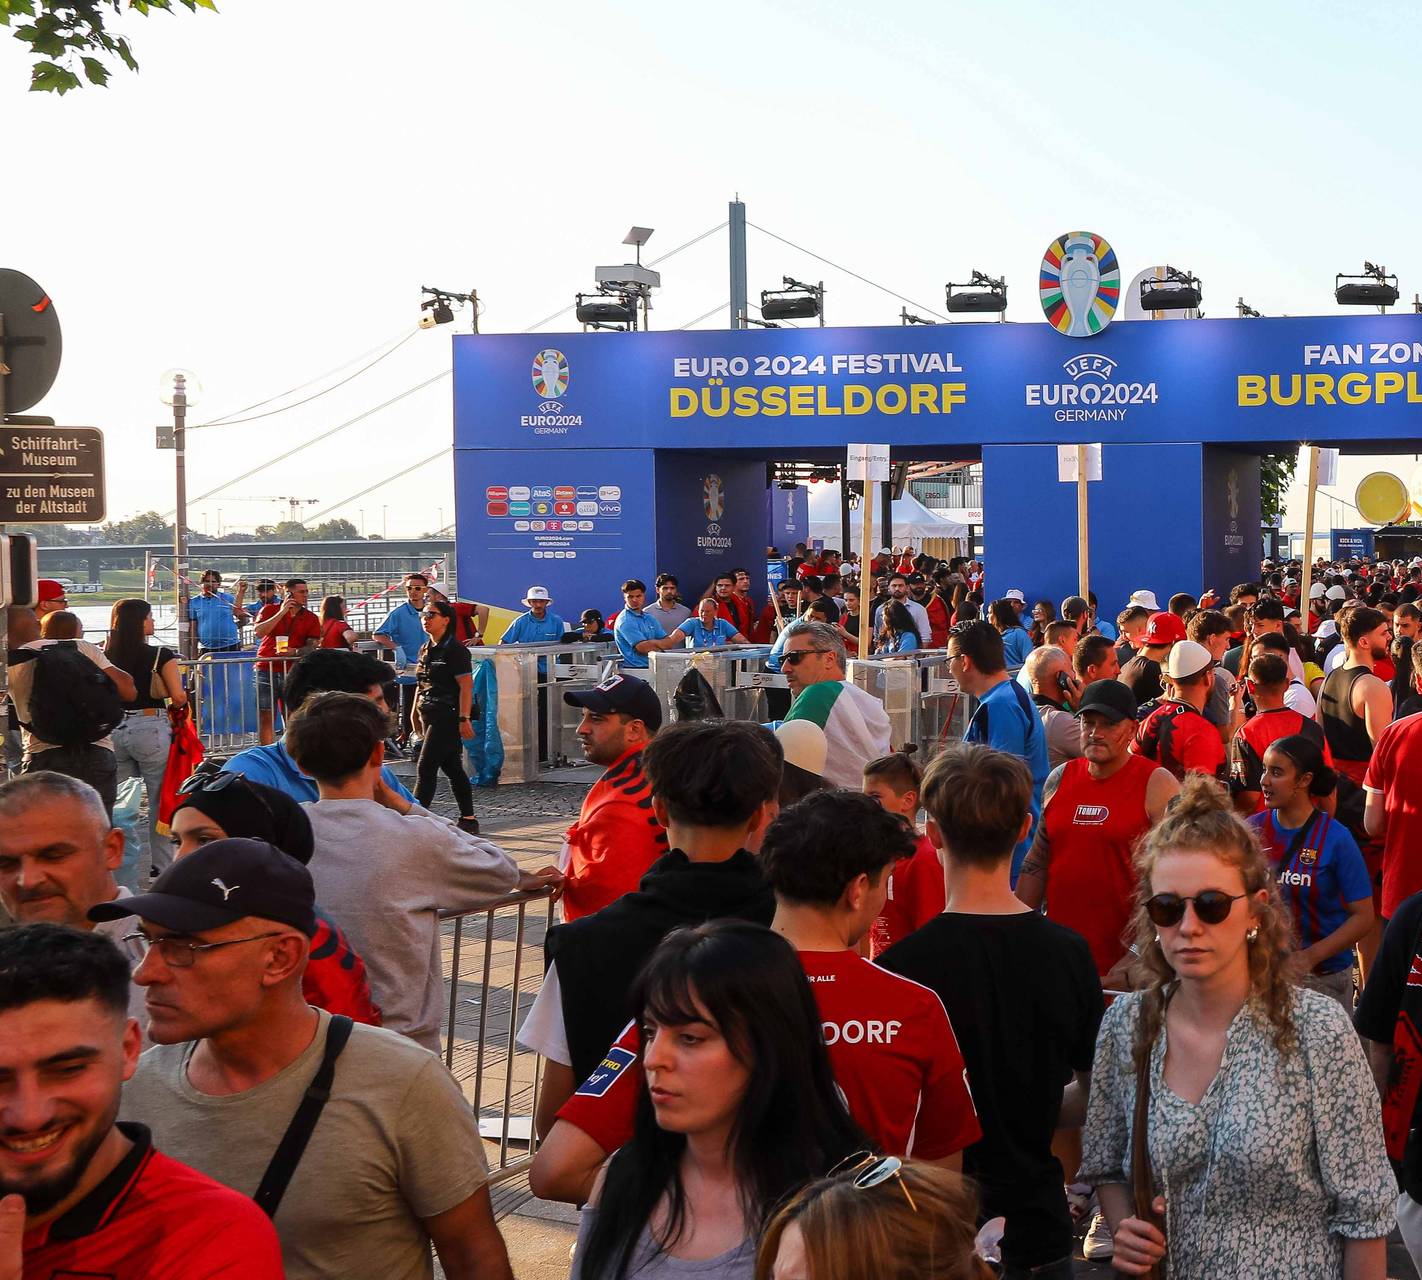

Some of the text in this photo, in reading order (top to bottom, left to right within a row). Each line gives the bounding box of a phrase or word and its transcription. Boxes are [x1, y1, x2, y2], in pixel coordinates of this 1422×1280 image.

[1304, 343, 1364, 366] FAN
[673, 352, 963, 378] EURO 2024 FESTIVAL
[1064, 356, 1116, 378] UEFA
[669, 377, 967, 418] DÜSSELDORF
[1025, 382, 1159, 407] EURO2024
[539, 402, 563, 413] UEFA
[520, 415, 583, 427] EURO2024
[1054, 408, 1127, 423] GERMANY
[534, 427, 568, 435] GERMANY
[11, 436, 86, 450] Schiffahrt-
[23, 453, 77, 466] Museum
[6, 485, 95, 498] zu den Museen
[16, 500, 87, 514] der Altstadt
[697, 536, 733, 548] EURO2024
[1078, 806, 1102, 816] TOMMY
[817, 974, 836, 983] ALLE
